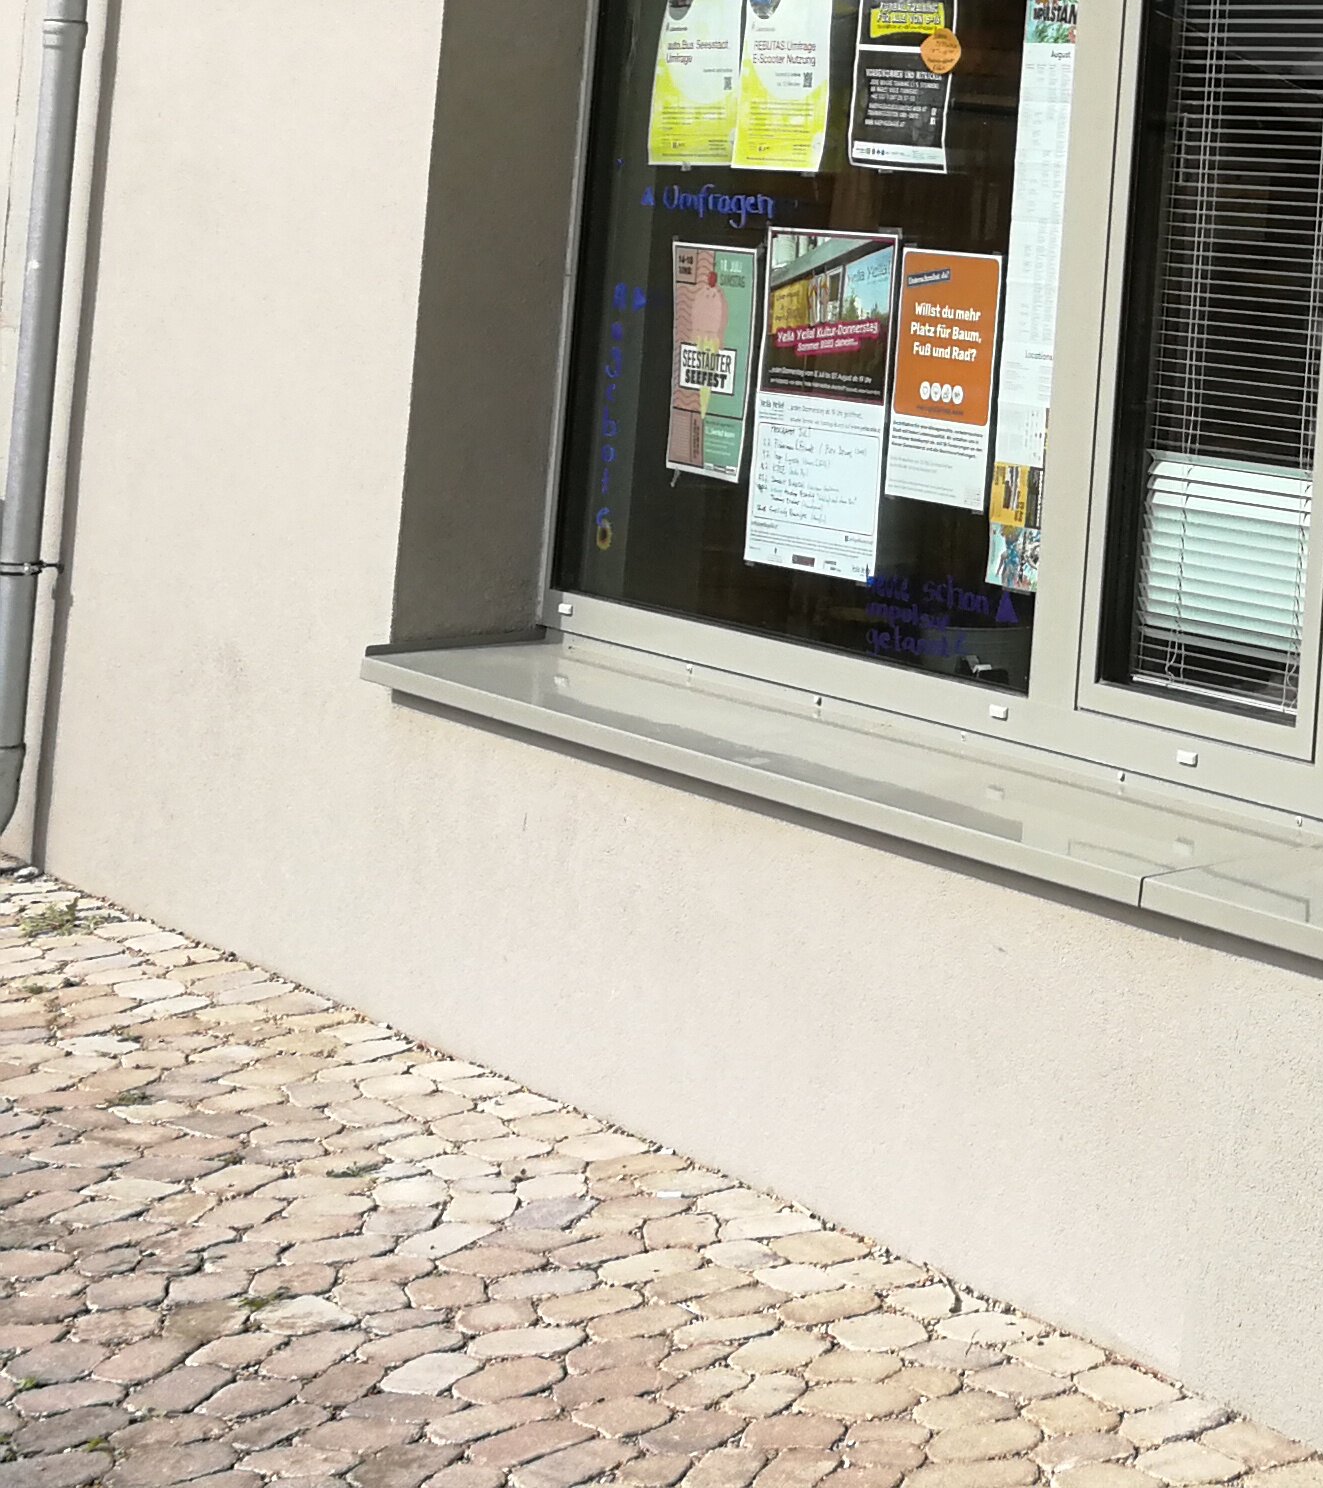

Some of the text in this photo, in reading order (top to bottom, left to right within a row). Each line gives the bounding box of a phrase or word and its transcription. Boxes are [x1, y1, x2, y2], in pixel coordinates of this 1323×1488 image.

[664, 185, 774, 229] Umfragen
[914, 302, 981, 322] Willst du mehr
[910, 322, 935, 337] Platz
[936, 323, 951, 338] für
[682, 348, 732, 375] SEESTÄDTER
[932, 345, 950, 359] und
[951, 346, 977, 362] Rad?
[684, 368, 728, 389] SEEFEST
